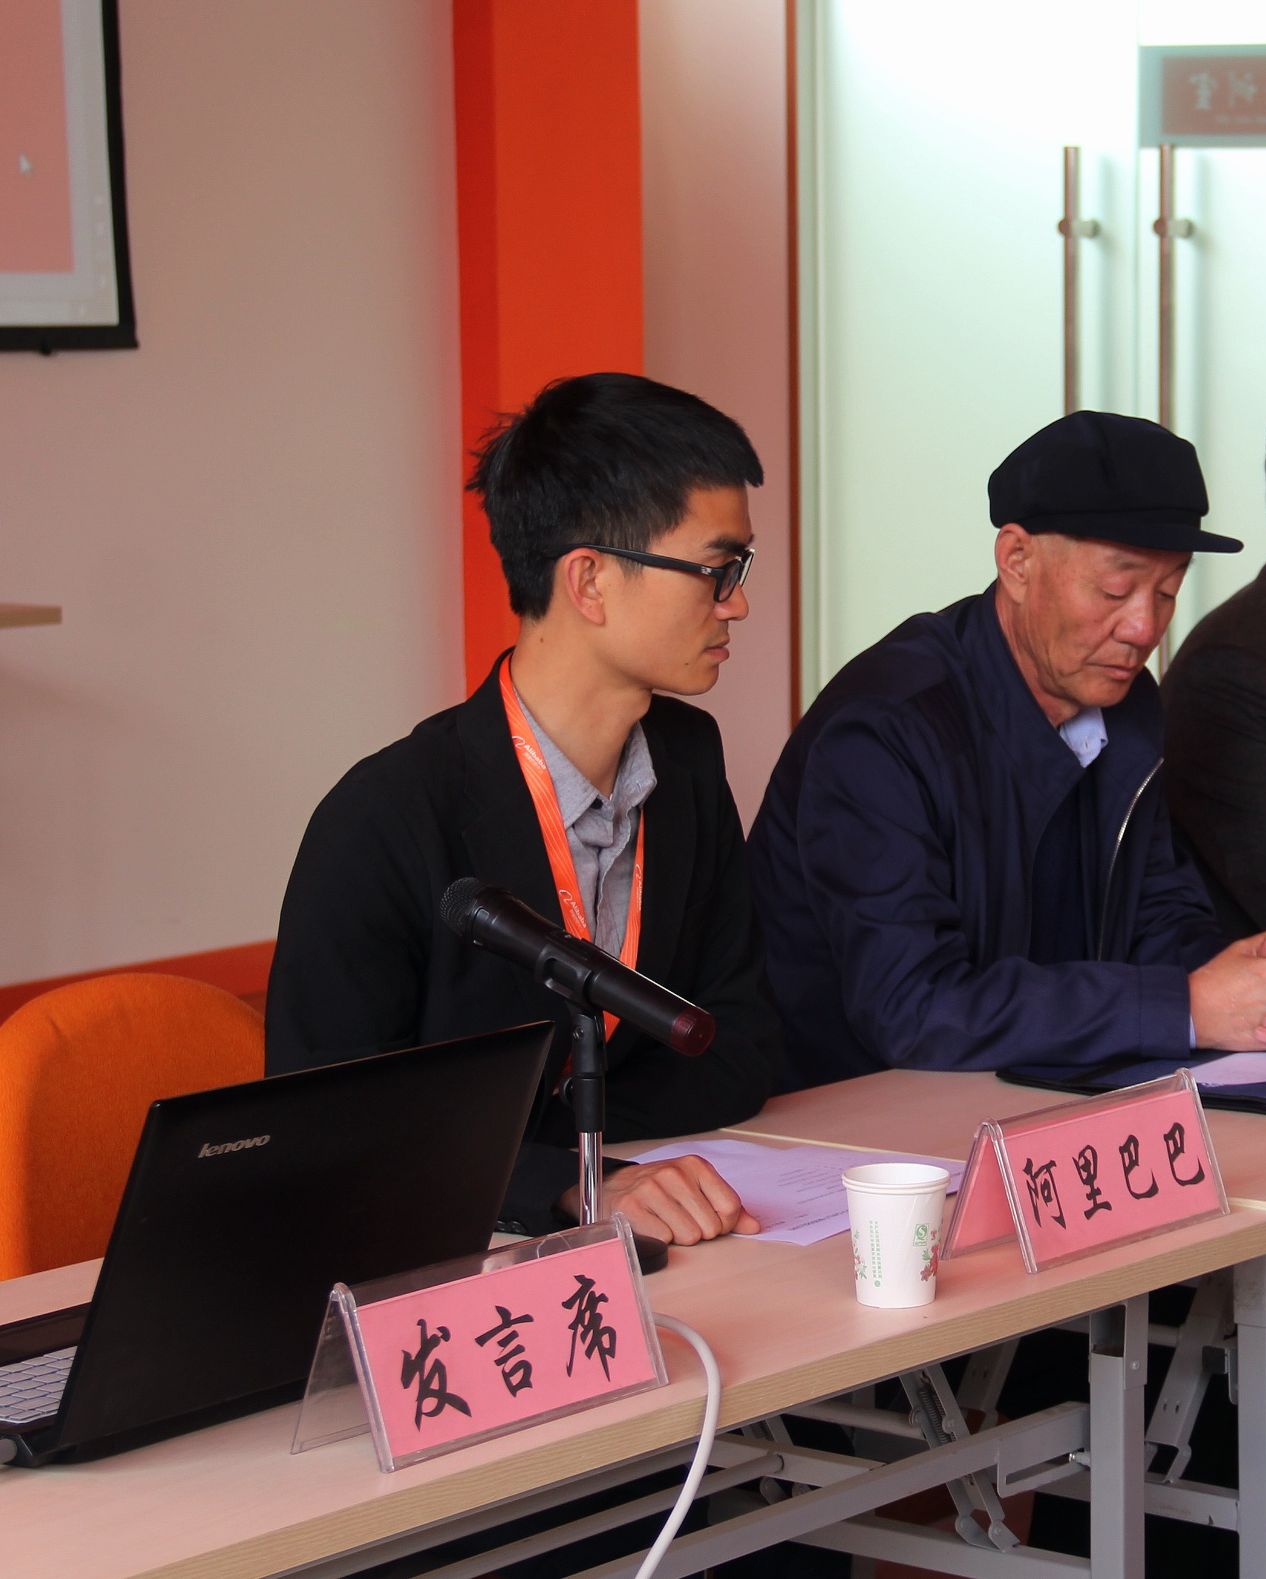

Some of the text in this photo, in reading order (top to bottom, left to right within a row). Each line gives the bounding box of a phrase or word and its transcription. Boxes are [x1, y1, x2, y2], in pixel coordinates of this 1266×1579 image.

[198, 1134, 271, 1159] lenovo
[1022, 1121, 1205, 1230] 阿里巴巴
[401, 1275, 617, 1431] 发言席
